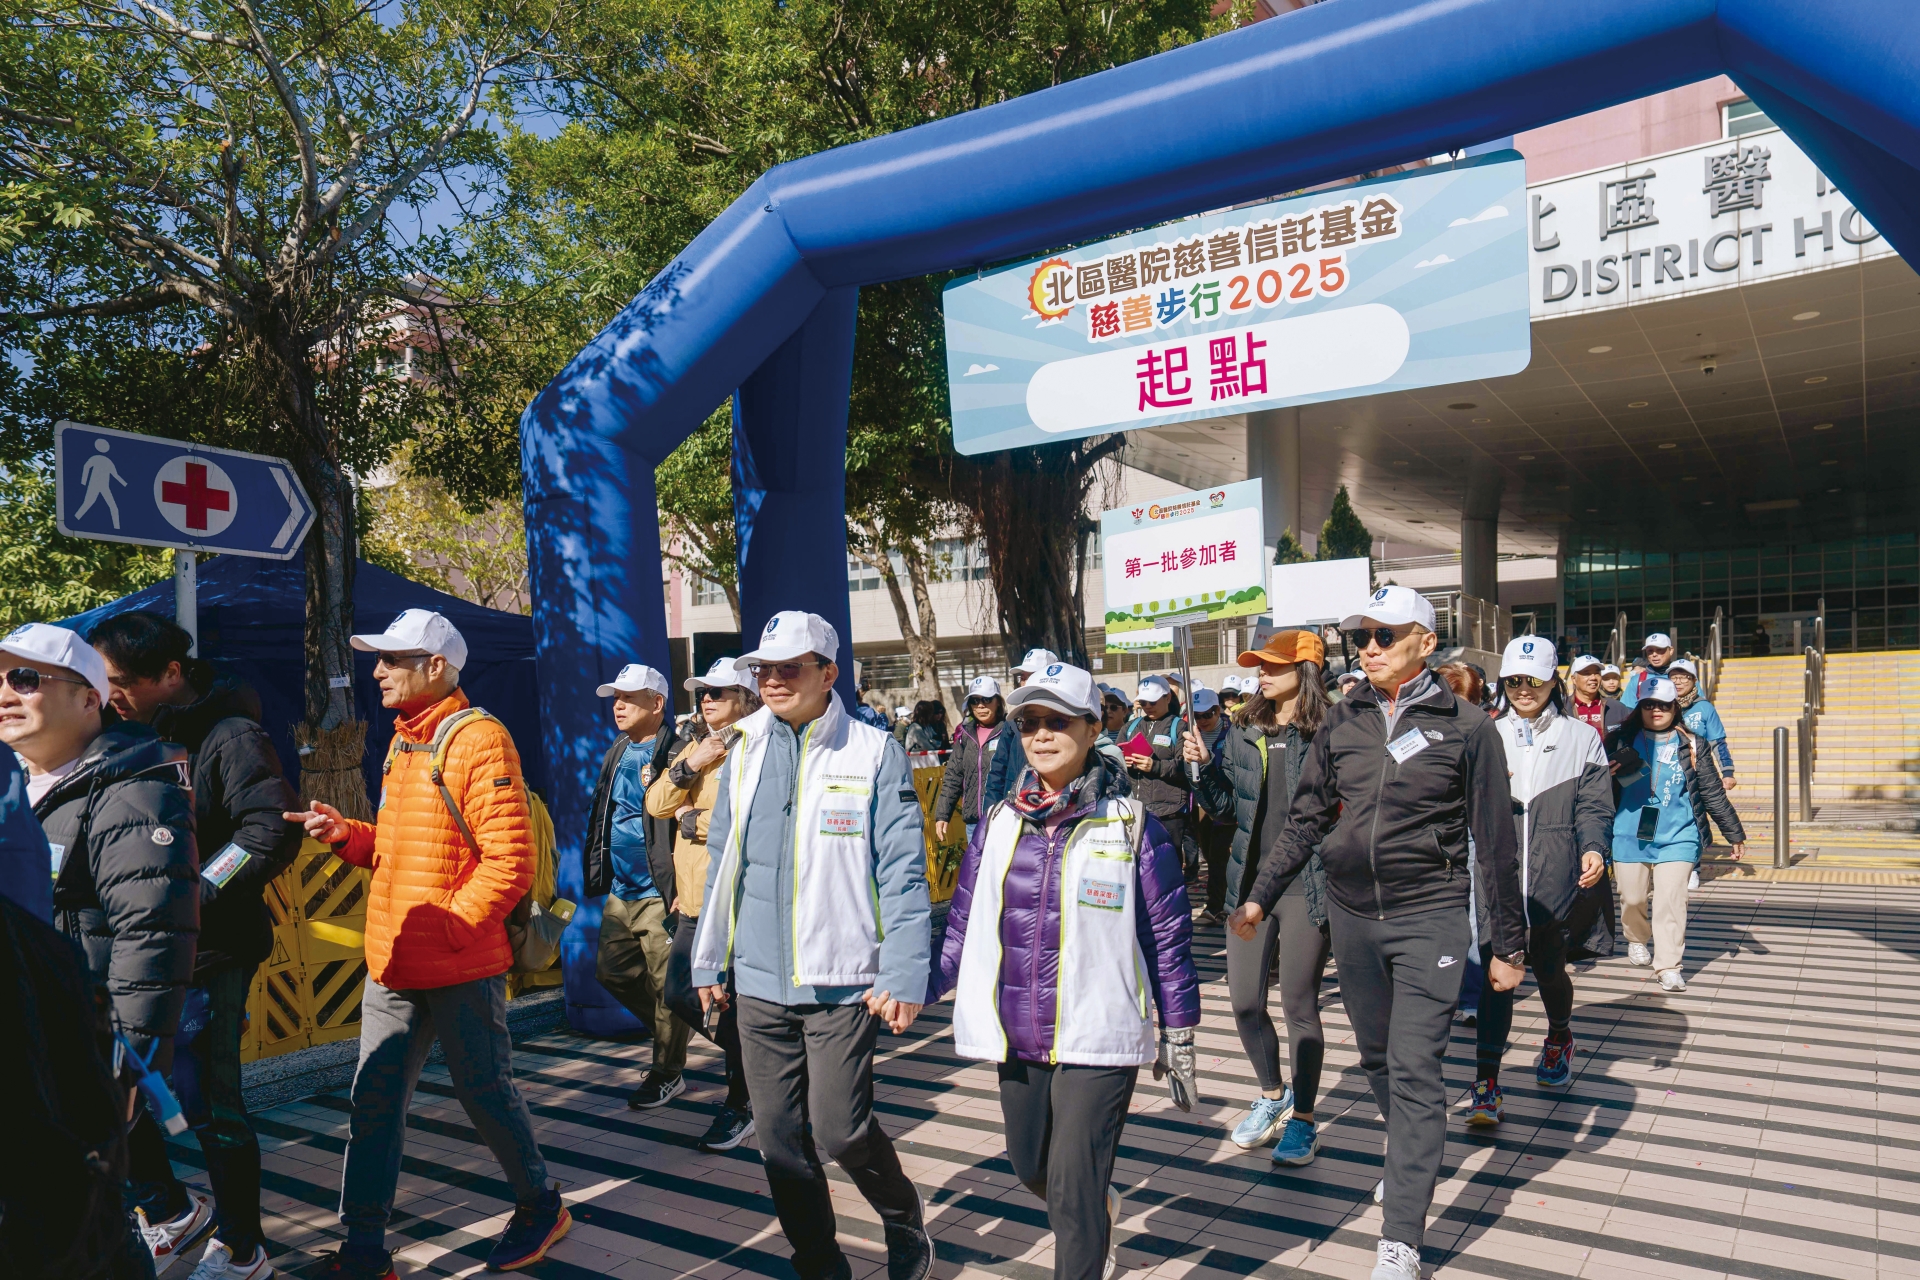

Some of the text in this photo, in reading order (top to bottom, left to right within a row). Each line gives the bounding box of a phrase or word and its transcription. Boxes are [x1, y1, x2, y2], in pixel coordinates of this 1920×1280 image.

[1046, 199, 1398, 307] 北區醫院慈善信託基金
[1543, 223, 1772, 303] DISTRICT
[1090, 256, 1345, 339] 慈善步行2025
[1136, 331, 1268, 412] 起點
[1125, 540, 1237, 579] 第一批參加者
